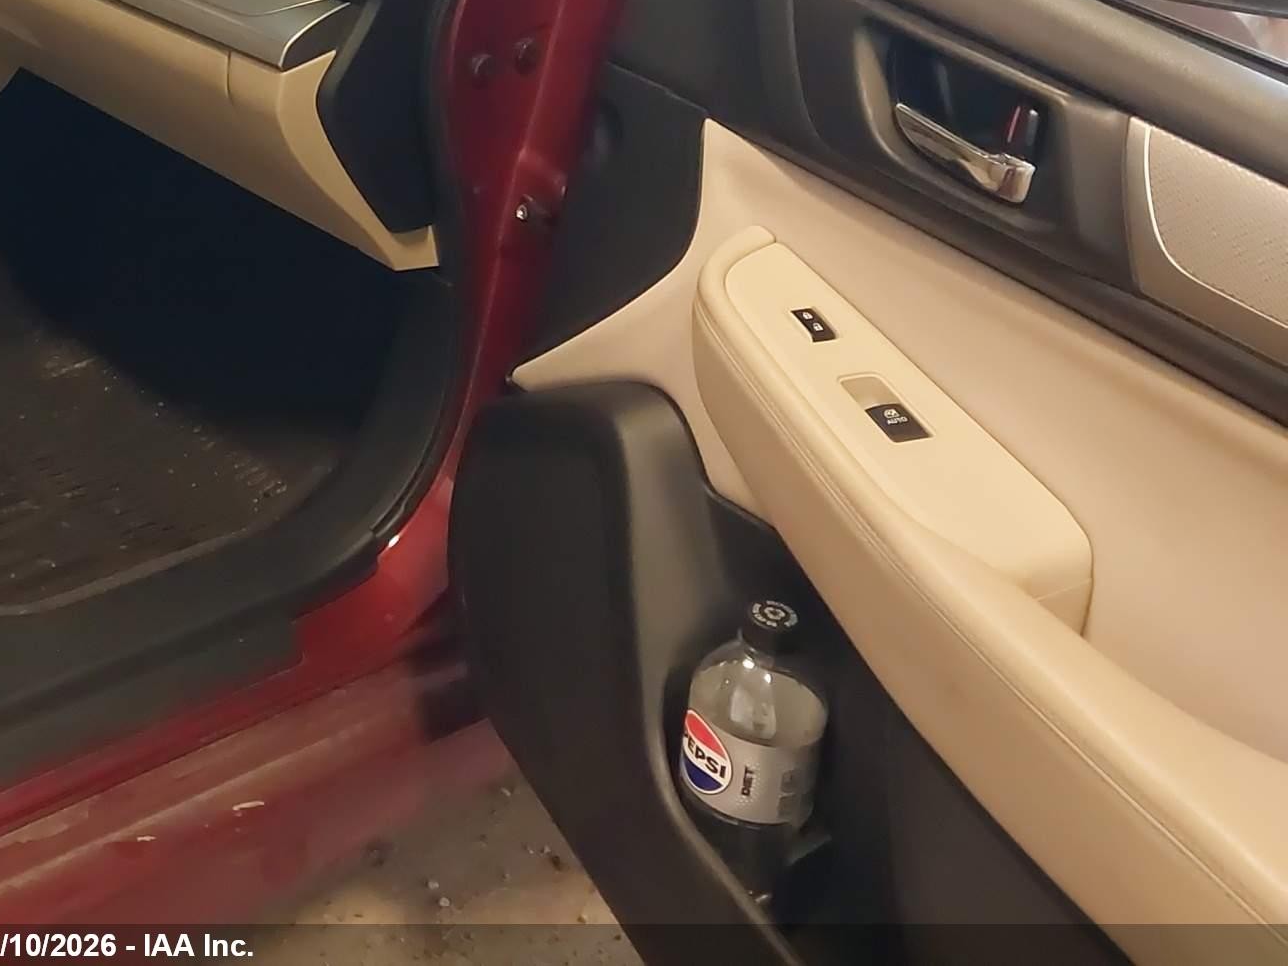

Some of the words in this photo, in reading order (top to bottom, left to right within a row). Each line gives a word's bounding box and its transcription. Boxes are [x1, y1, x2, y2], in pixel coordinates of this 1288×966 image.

[887, 416, 909, 425] AUTO
[684, 732, 727, 779] EPSI
[741, 765, 755, 797] DIET
